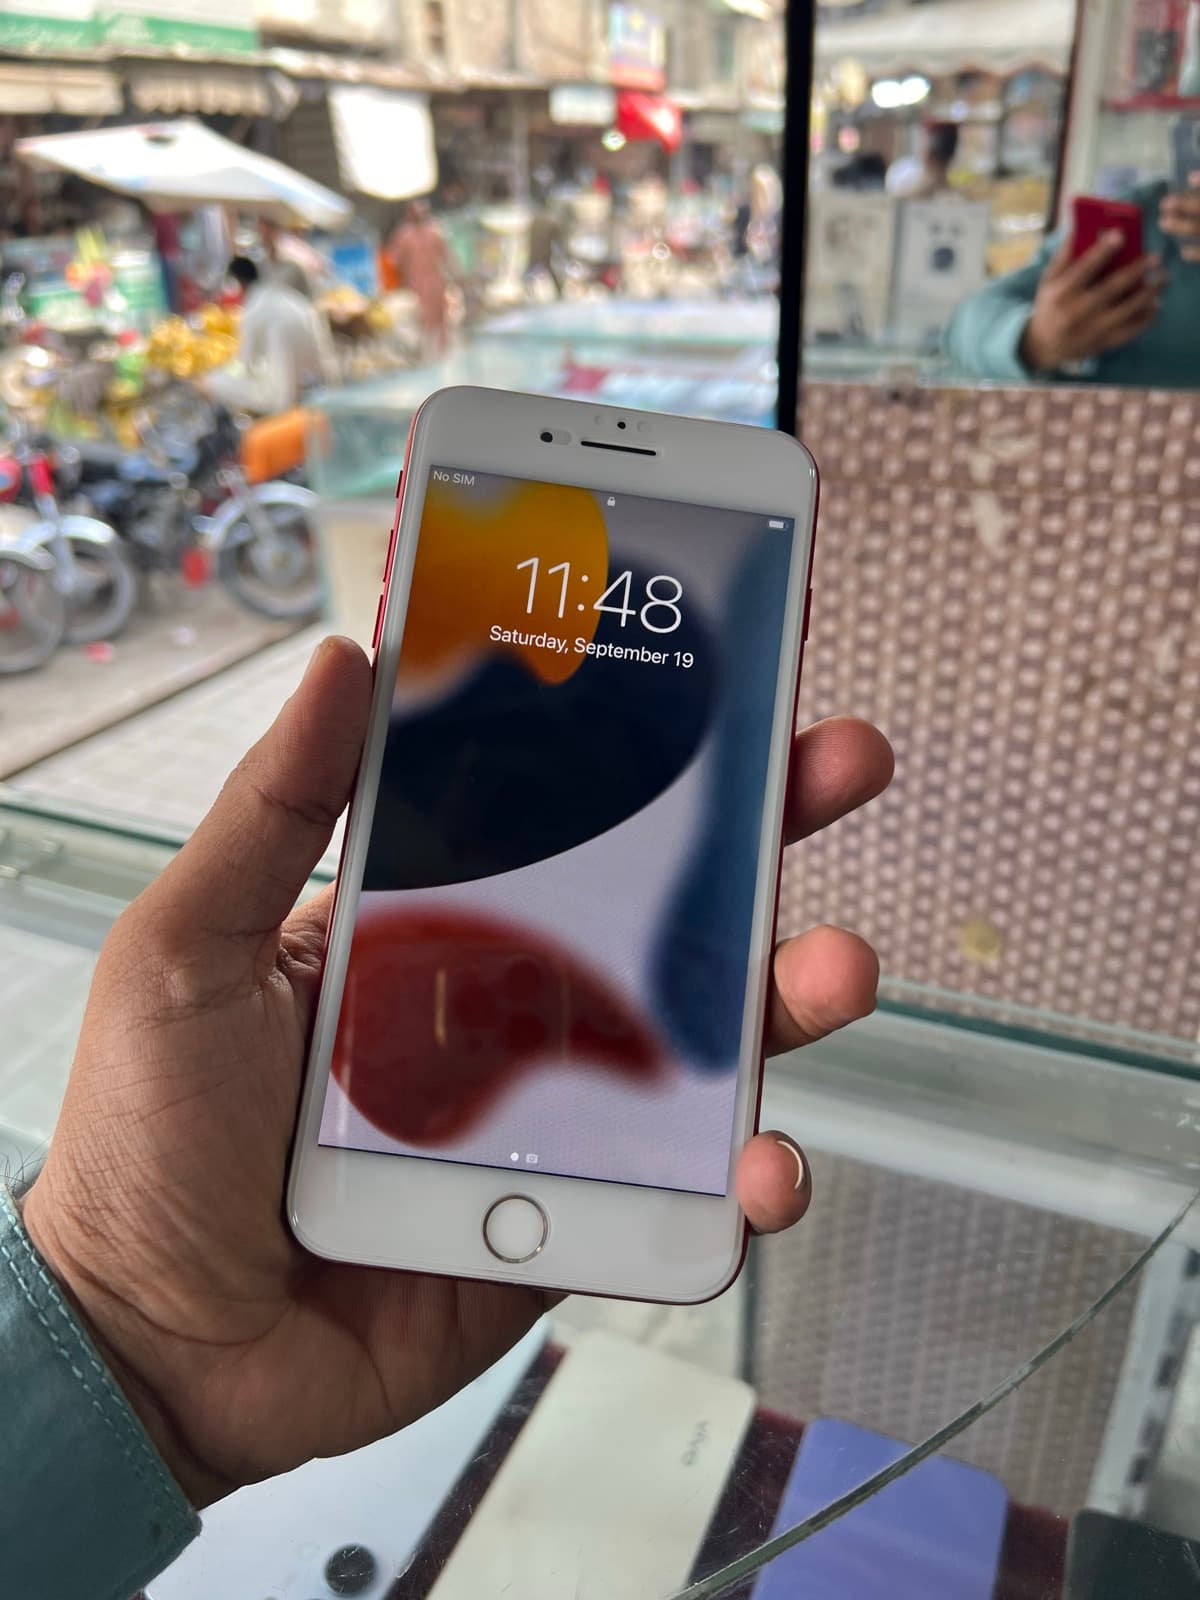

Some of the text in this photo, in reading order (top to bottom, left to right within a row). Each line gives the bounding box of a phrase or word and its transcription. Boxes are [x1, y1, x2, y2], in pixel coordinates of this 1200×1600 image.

[433, 470, 475, 486] No SIM
[516, 556, 683, 634] 11:48
[489, 624, 694, 669] Saturday, September 19
